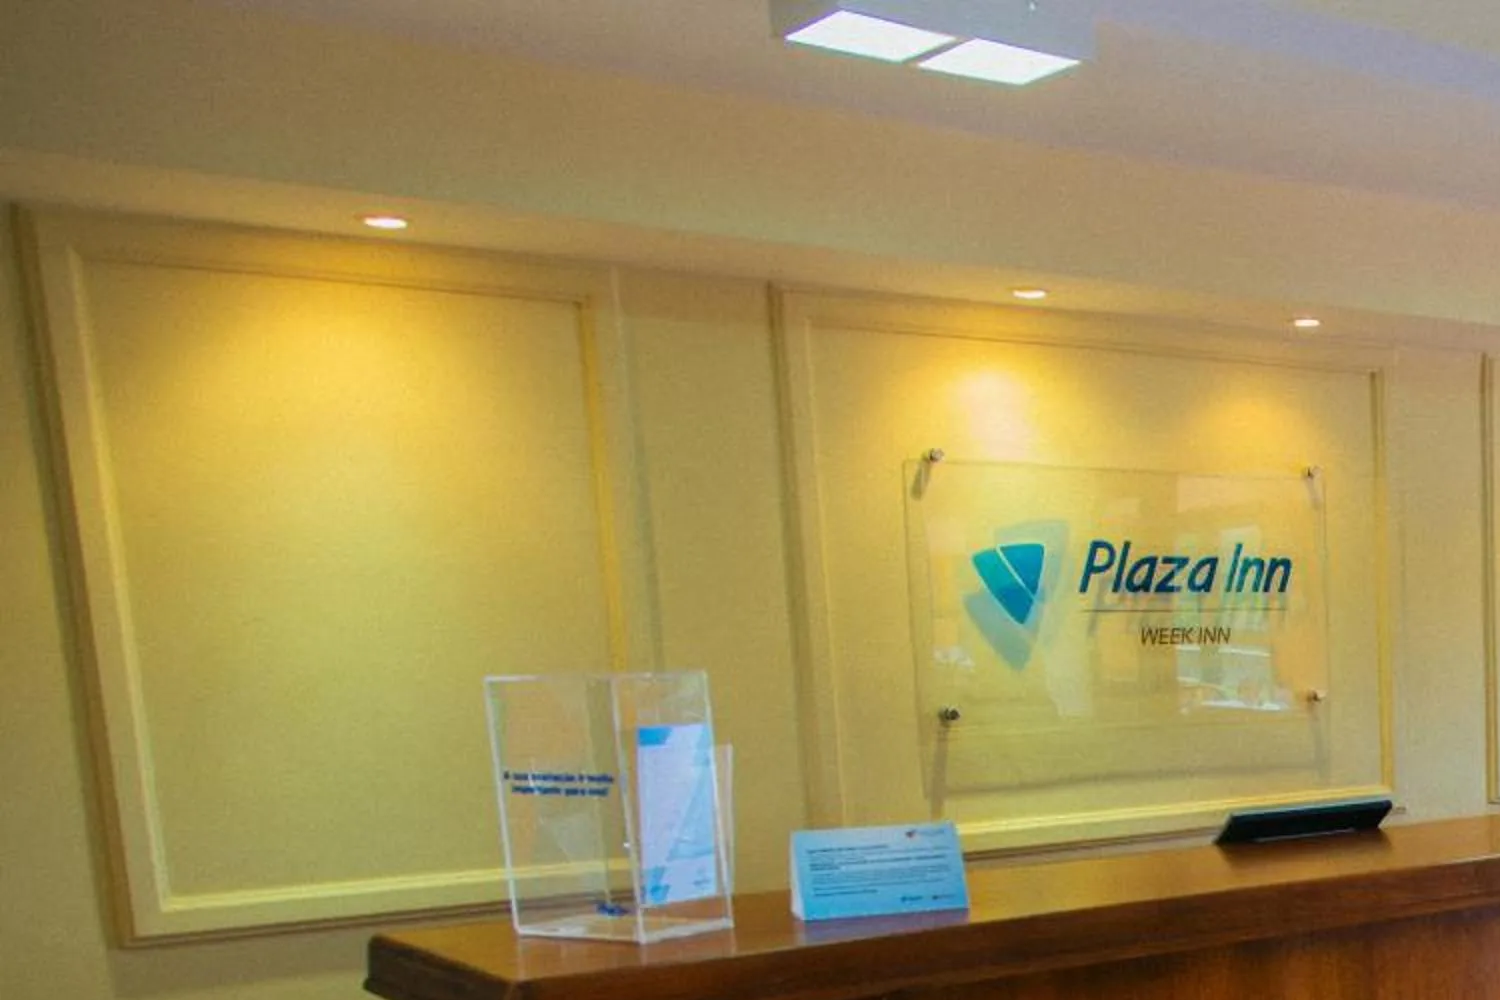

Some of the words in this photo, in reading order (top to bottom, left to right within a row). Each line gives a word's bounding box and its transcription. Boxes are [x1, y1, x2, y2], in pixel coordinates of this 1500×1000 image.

[1079, 539, 1219, 593] Plaza
[1225, 543, 1293, 593] Inn
[1140, 626, 1195, 645] WEEK
[1199, 627, 1231, 645] INN
